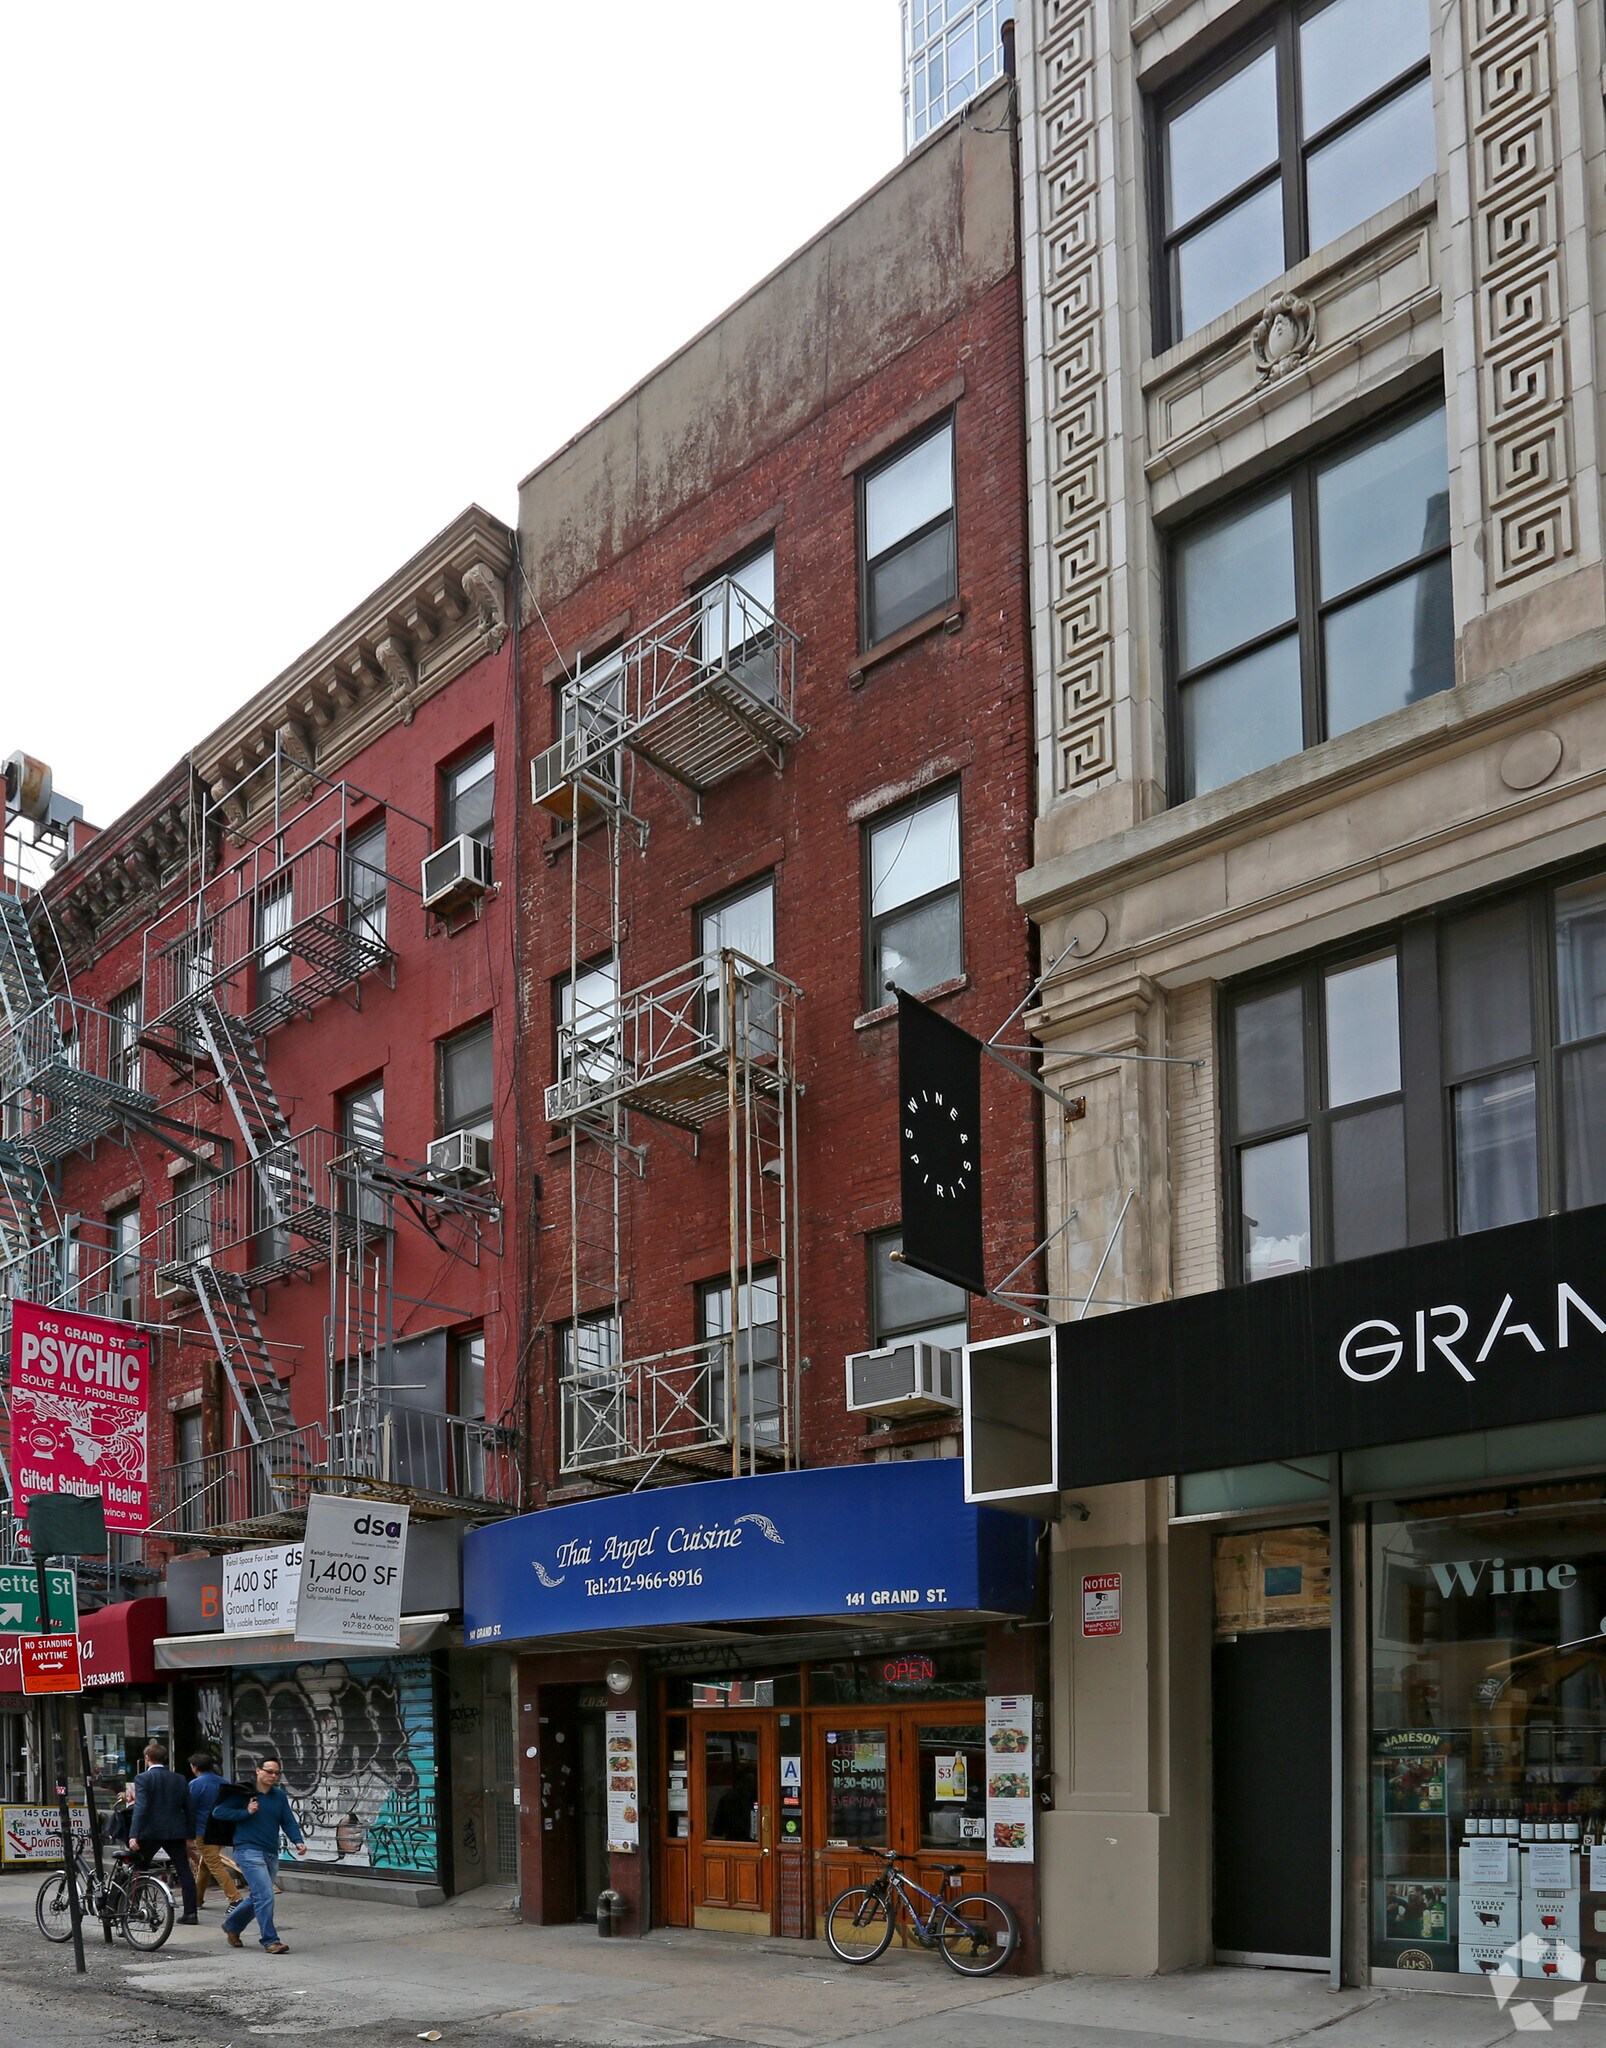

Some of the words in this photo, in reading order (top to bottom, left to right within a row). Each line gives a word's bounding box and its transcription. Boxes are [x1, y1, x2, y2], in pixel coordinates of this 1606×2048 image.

[907, 1090, 958, 1121] WINE
[960, 1133, 968, 1144] &
[905, 1128, 972, 1198] SPIRITS
[38, 1321, 59, 1334] 143
[64, 1327, 104, 1344] GRAND
[109, 1337, 125, 1350] ST.
[21, 1332, 140, 1391] PSYCHIC
[21, 1373, 54, 1388] SOLVE
[60, 1382, 79, 1394] ALL
[85, 1386, 139, 1405] PROBLEMS
[20, 1468, 54, 1492] Gifted
[58, 1474, 103, 1497] Spiritual
[108, 1482, 142, 1504] Healer
[128, 1511, 142, 1521] you
[354, 1514, 402, 1538] dsa
[556, 1538, 593, 1569] Thai
[600, 1525, 661, 1570] Angel
[667, 1522, 744, 1553] Cuisine
[226, 1557, 239, 1567] Retail
[239, 1556, 254, 1566] Space
[254, 1554, 263, 1562] For
[264, 1553, 278, 1562] Lease
[285, 1548, 302, 1566] ds
[309, 1560, 366, 1582] 1,400
[373, 1566, 398, 1586] SF
[585, 1567, 703, 1597] Tel:212-966-8916
[1425, 1558, 1578, 1598] Wine
[52, 1578, 71, 1596] St
[226, 1571, 259, 1598] 1,400
[264, 1568, 278, 1590] SF
[306, 1583, 341, 1594] Ground
[344, 1586, 366, 1596] Floor
[1084, 1578, 1120, 1590] NOTICE
[846, 1592, 865, 1606] 141
[871, 1590, 920, 1605] GRAND
[926, 1588, 948, 1603] ST.
[226, 1599, 254, 1616] Ground
[258, 1598, 279, 1612] Floor
[237, 1618, 253, 1628] usable
[254, 1617, 280, 1626] basement
[350, 1612, 366, 1620] Alex
[369, 1614, 394, 1622] Mecum
[342, 1621, 394, 1632] 917-826-0060
[25, 1642, 34, 1650] NO
[38, 1639, 73, 1649] STANDING
[32, 1651, 68, 1660] ANYTIME
[884, 1661, 933, 1681] OPEN
[1384, 1732, 1440, 1748] JAMESON
[784, 1760, 798, 1778] A
[938, 1768, 951, 1780] $3
[23, 1809, 38, 1817] 145
[42, 1809, 61, 1817] Gra
[72, 1809, 84, 1817] St.
[18, 1828, 42, 1836] Back
[39, 1818, 58, 1828] Wu
